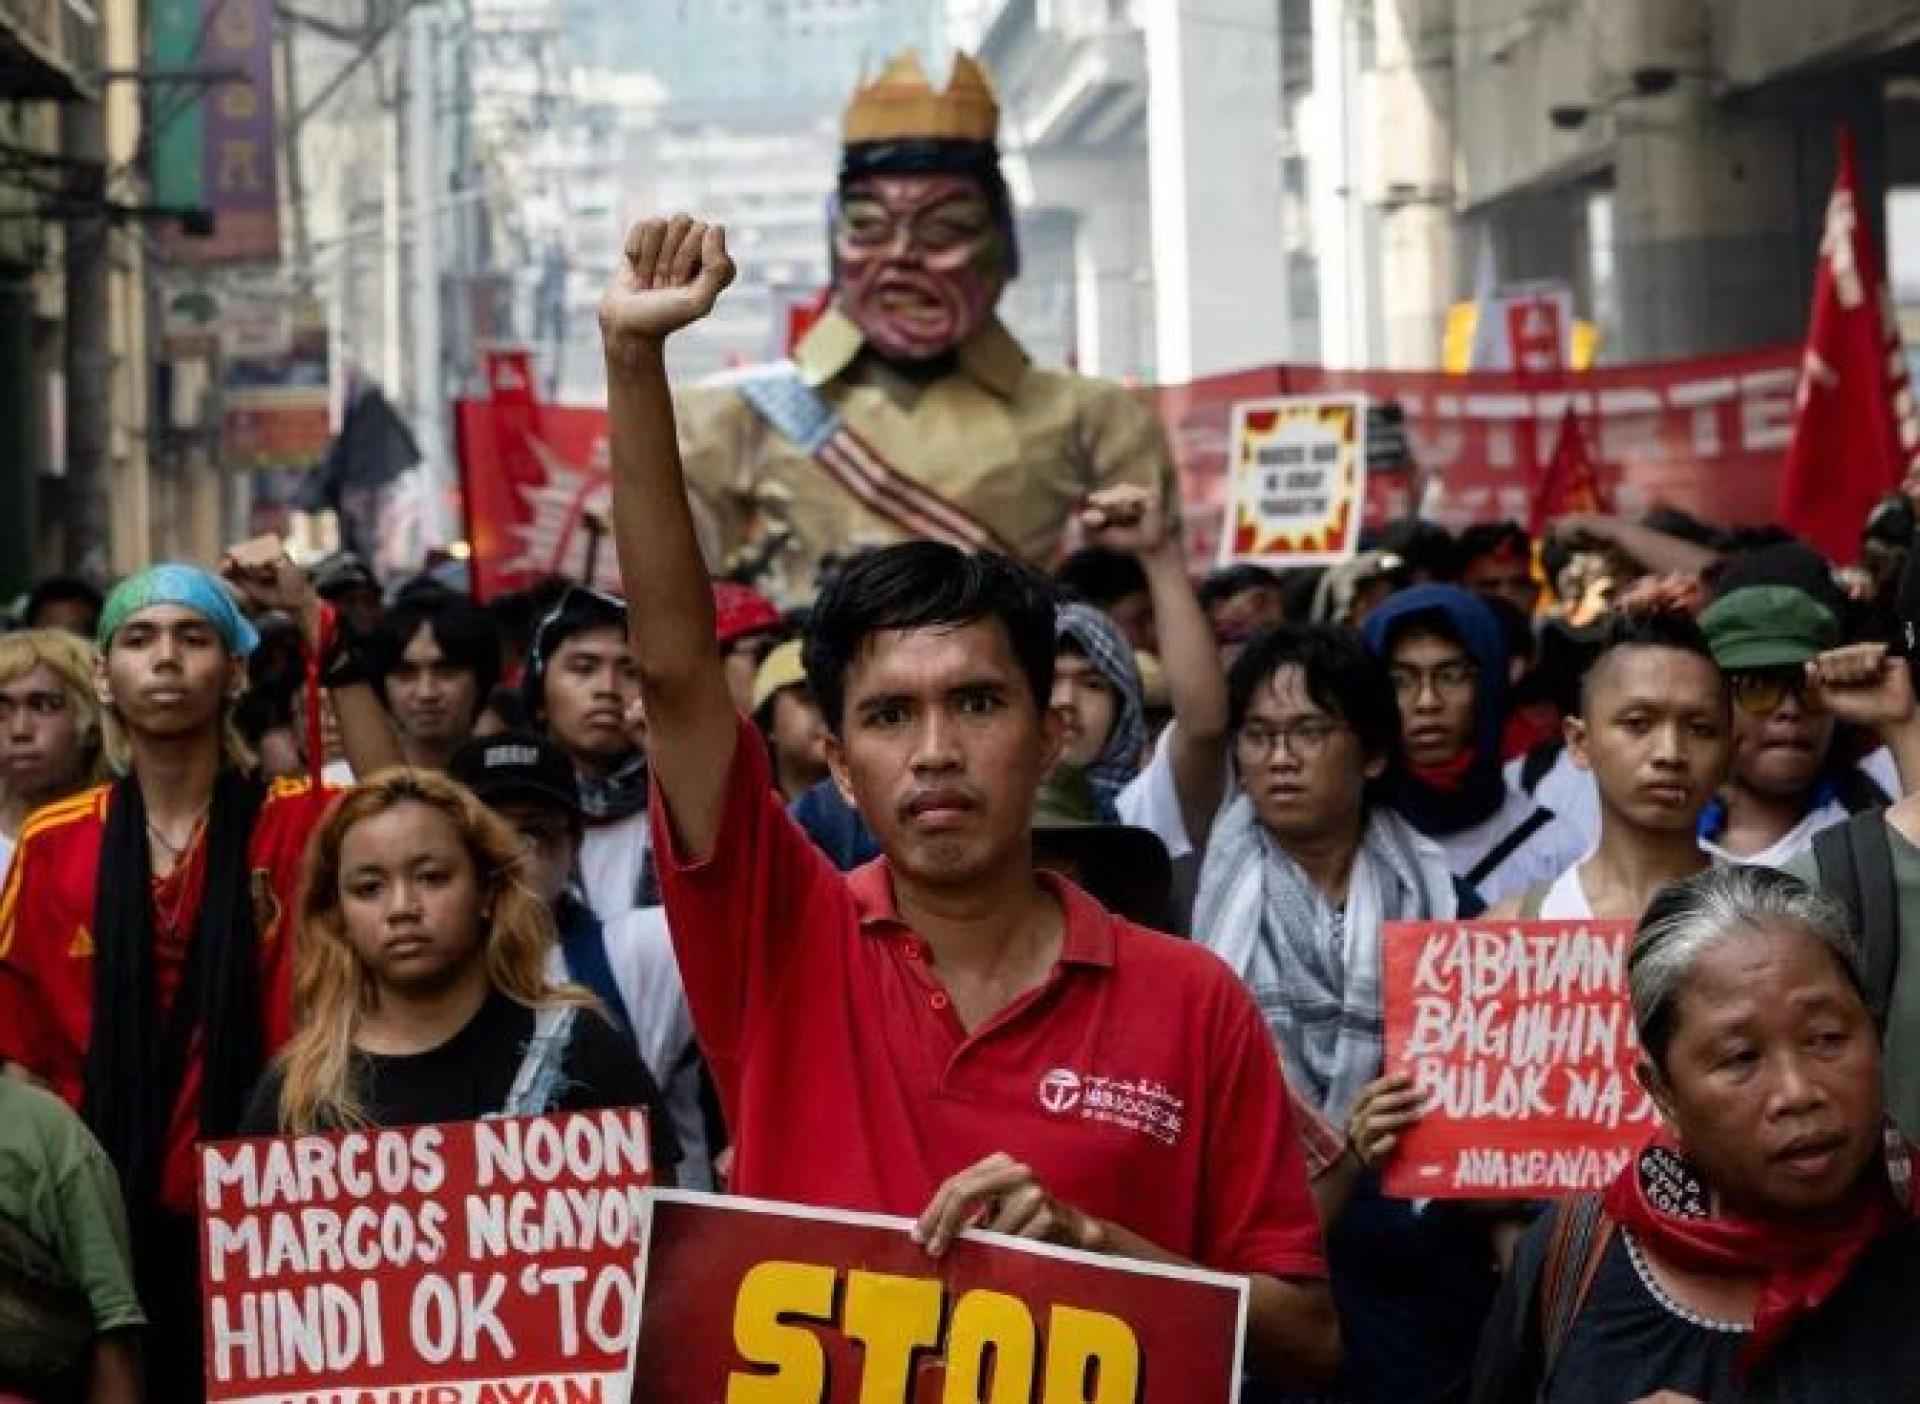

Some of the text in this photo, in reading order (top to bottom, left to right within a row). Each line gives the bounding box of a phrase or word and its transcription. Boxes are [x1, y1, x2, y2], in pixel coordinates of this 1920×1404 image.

[1404, 995, 1622, 1069] BAGUHIN
[1414, 1056, 1556, 1120] BULOK
[1565, 1065, 1622, 1129] NA
[203, 1108, 649, 1210] MARCOS NOON
[208, 1200, 448, 1282] MARCOS
[211, 1278, 384, 1381] HINDI
[410, 1272, 516, 1362] OK
